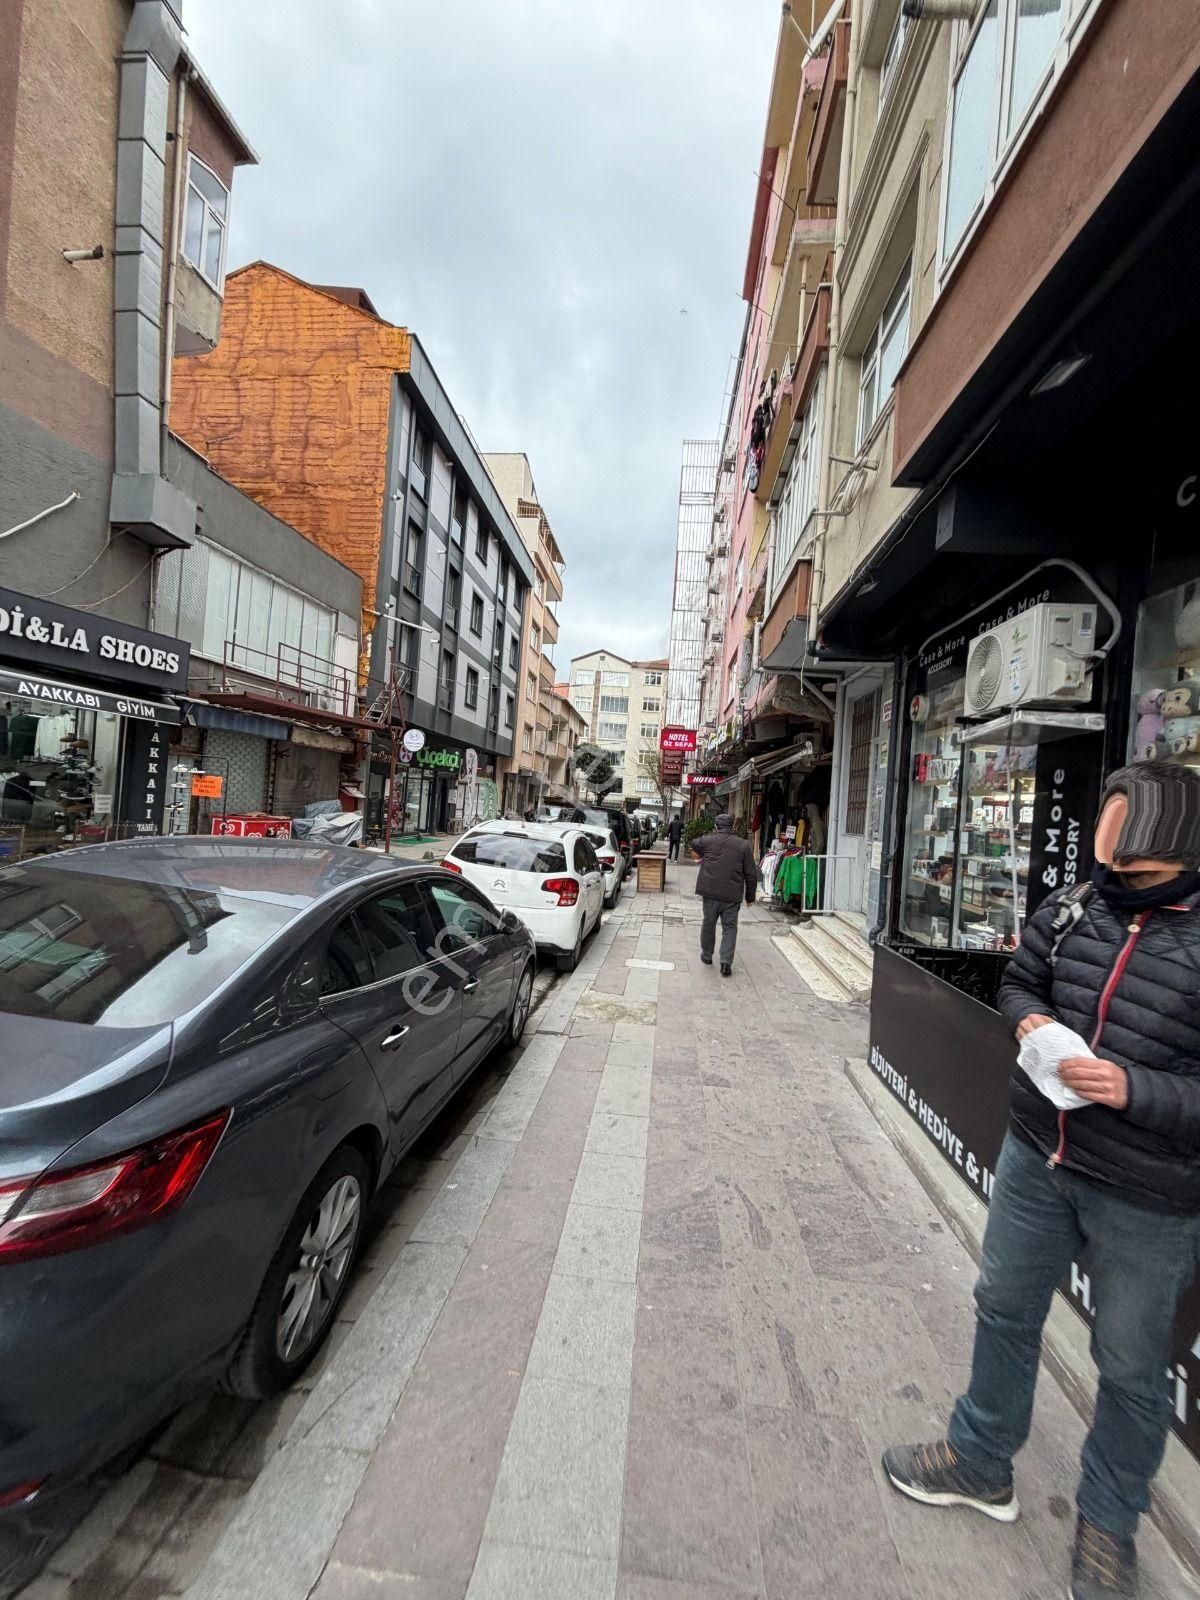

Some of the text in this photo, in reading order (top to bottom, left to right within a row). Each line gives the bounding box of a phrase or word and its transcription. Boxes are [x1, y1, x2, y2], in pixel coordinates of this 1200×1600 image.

[100, 635, 180, 674] SHOES
[919, 652, 936, 667] Case
[944, 636, 966, 654] More
[927, 657, 953, 674] ACCESSORY
[18, 681, 156, 718] AYAKKABI GİYİM
[668, 734, 689, 742] HOTEL
[416, 745, 460, 772] Çiçekçi
[692, 776, 717, 784] HOTEL
[1044, 768, 1065, 853] More
[871, 1046, 908, 1101] BİJUTERİ
[908, 1088, 918, 1113] &
[918, 1098, 964, 1167] HEDİYE
[965, 1152, 980, 1184] &
